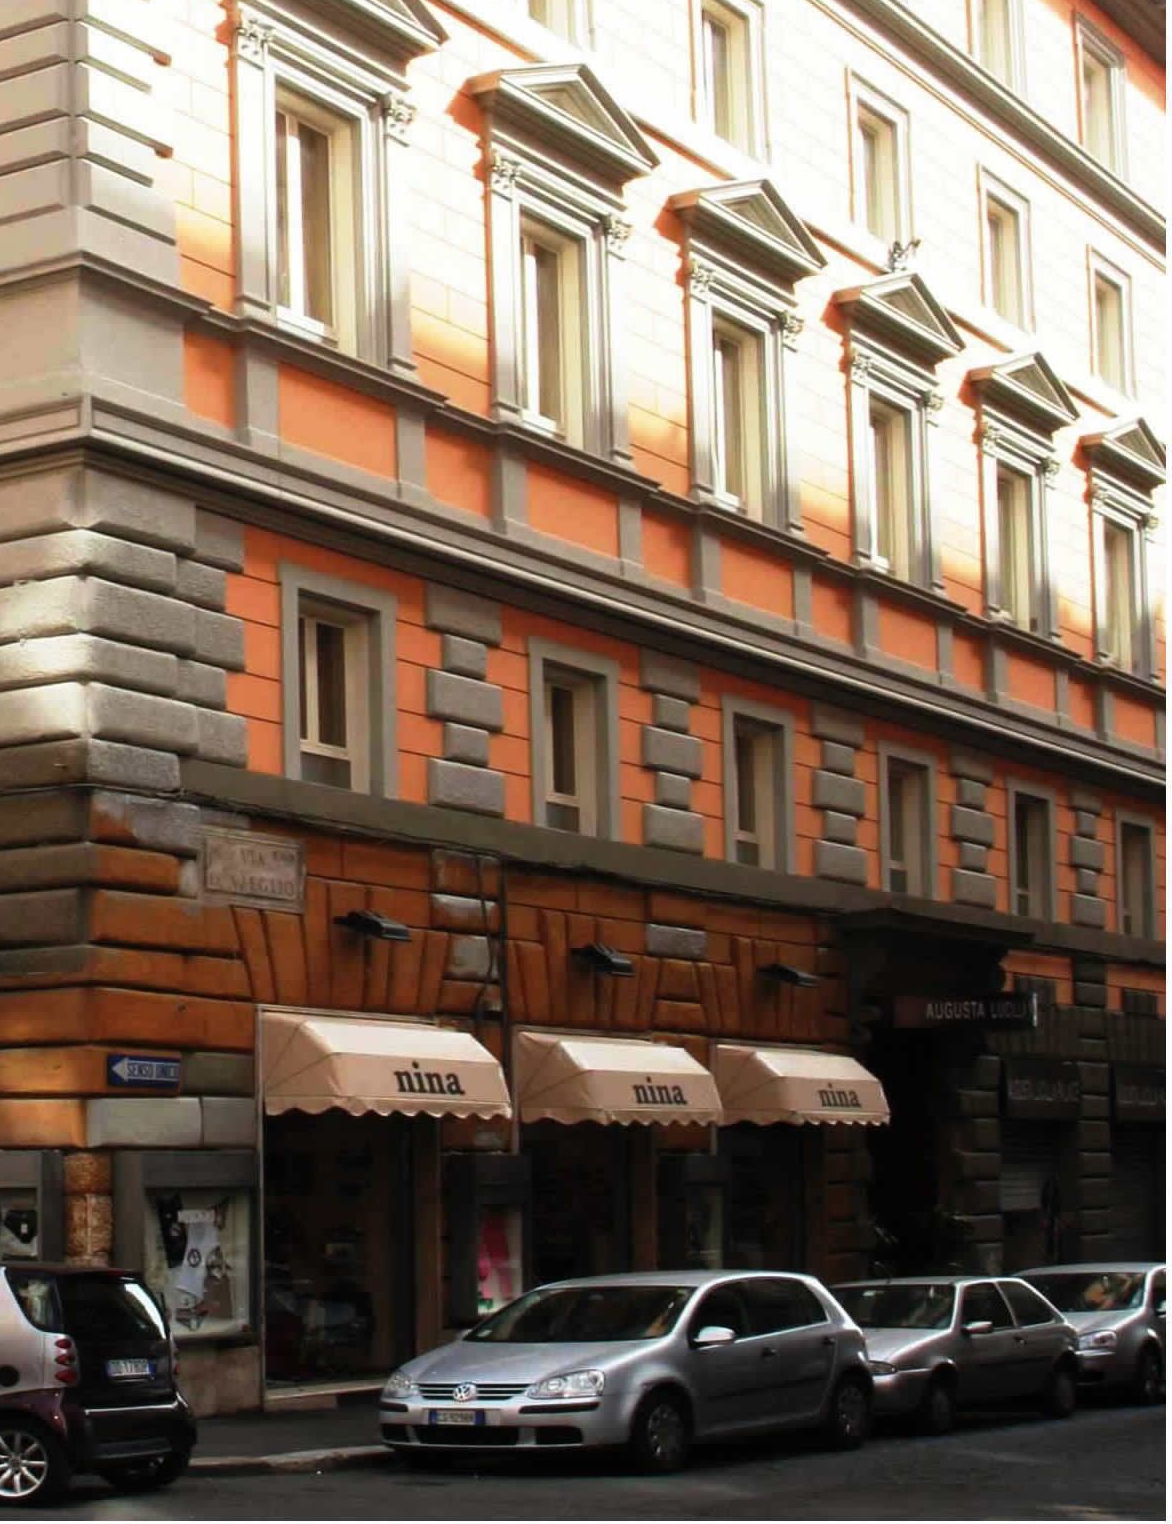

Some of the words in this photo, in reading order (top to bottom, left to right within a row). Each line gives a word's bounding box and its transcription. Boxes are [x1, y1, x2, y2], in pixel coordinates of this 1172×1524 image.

[926, 1001, 986, 1020] AUGUSTA
[127, 1064, 154, 1078] SENSO
[394, 1061, 465, 1095] nina
[633, 1077, 687, 1105] nina
[818, 1083, 860, 1108] nina
